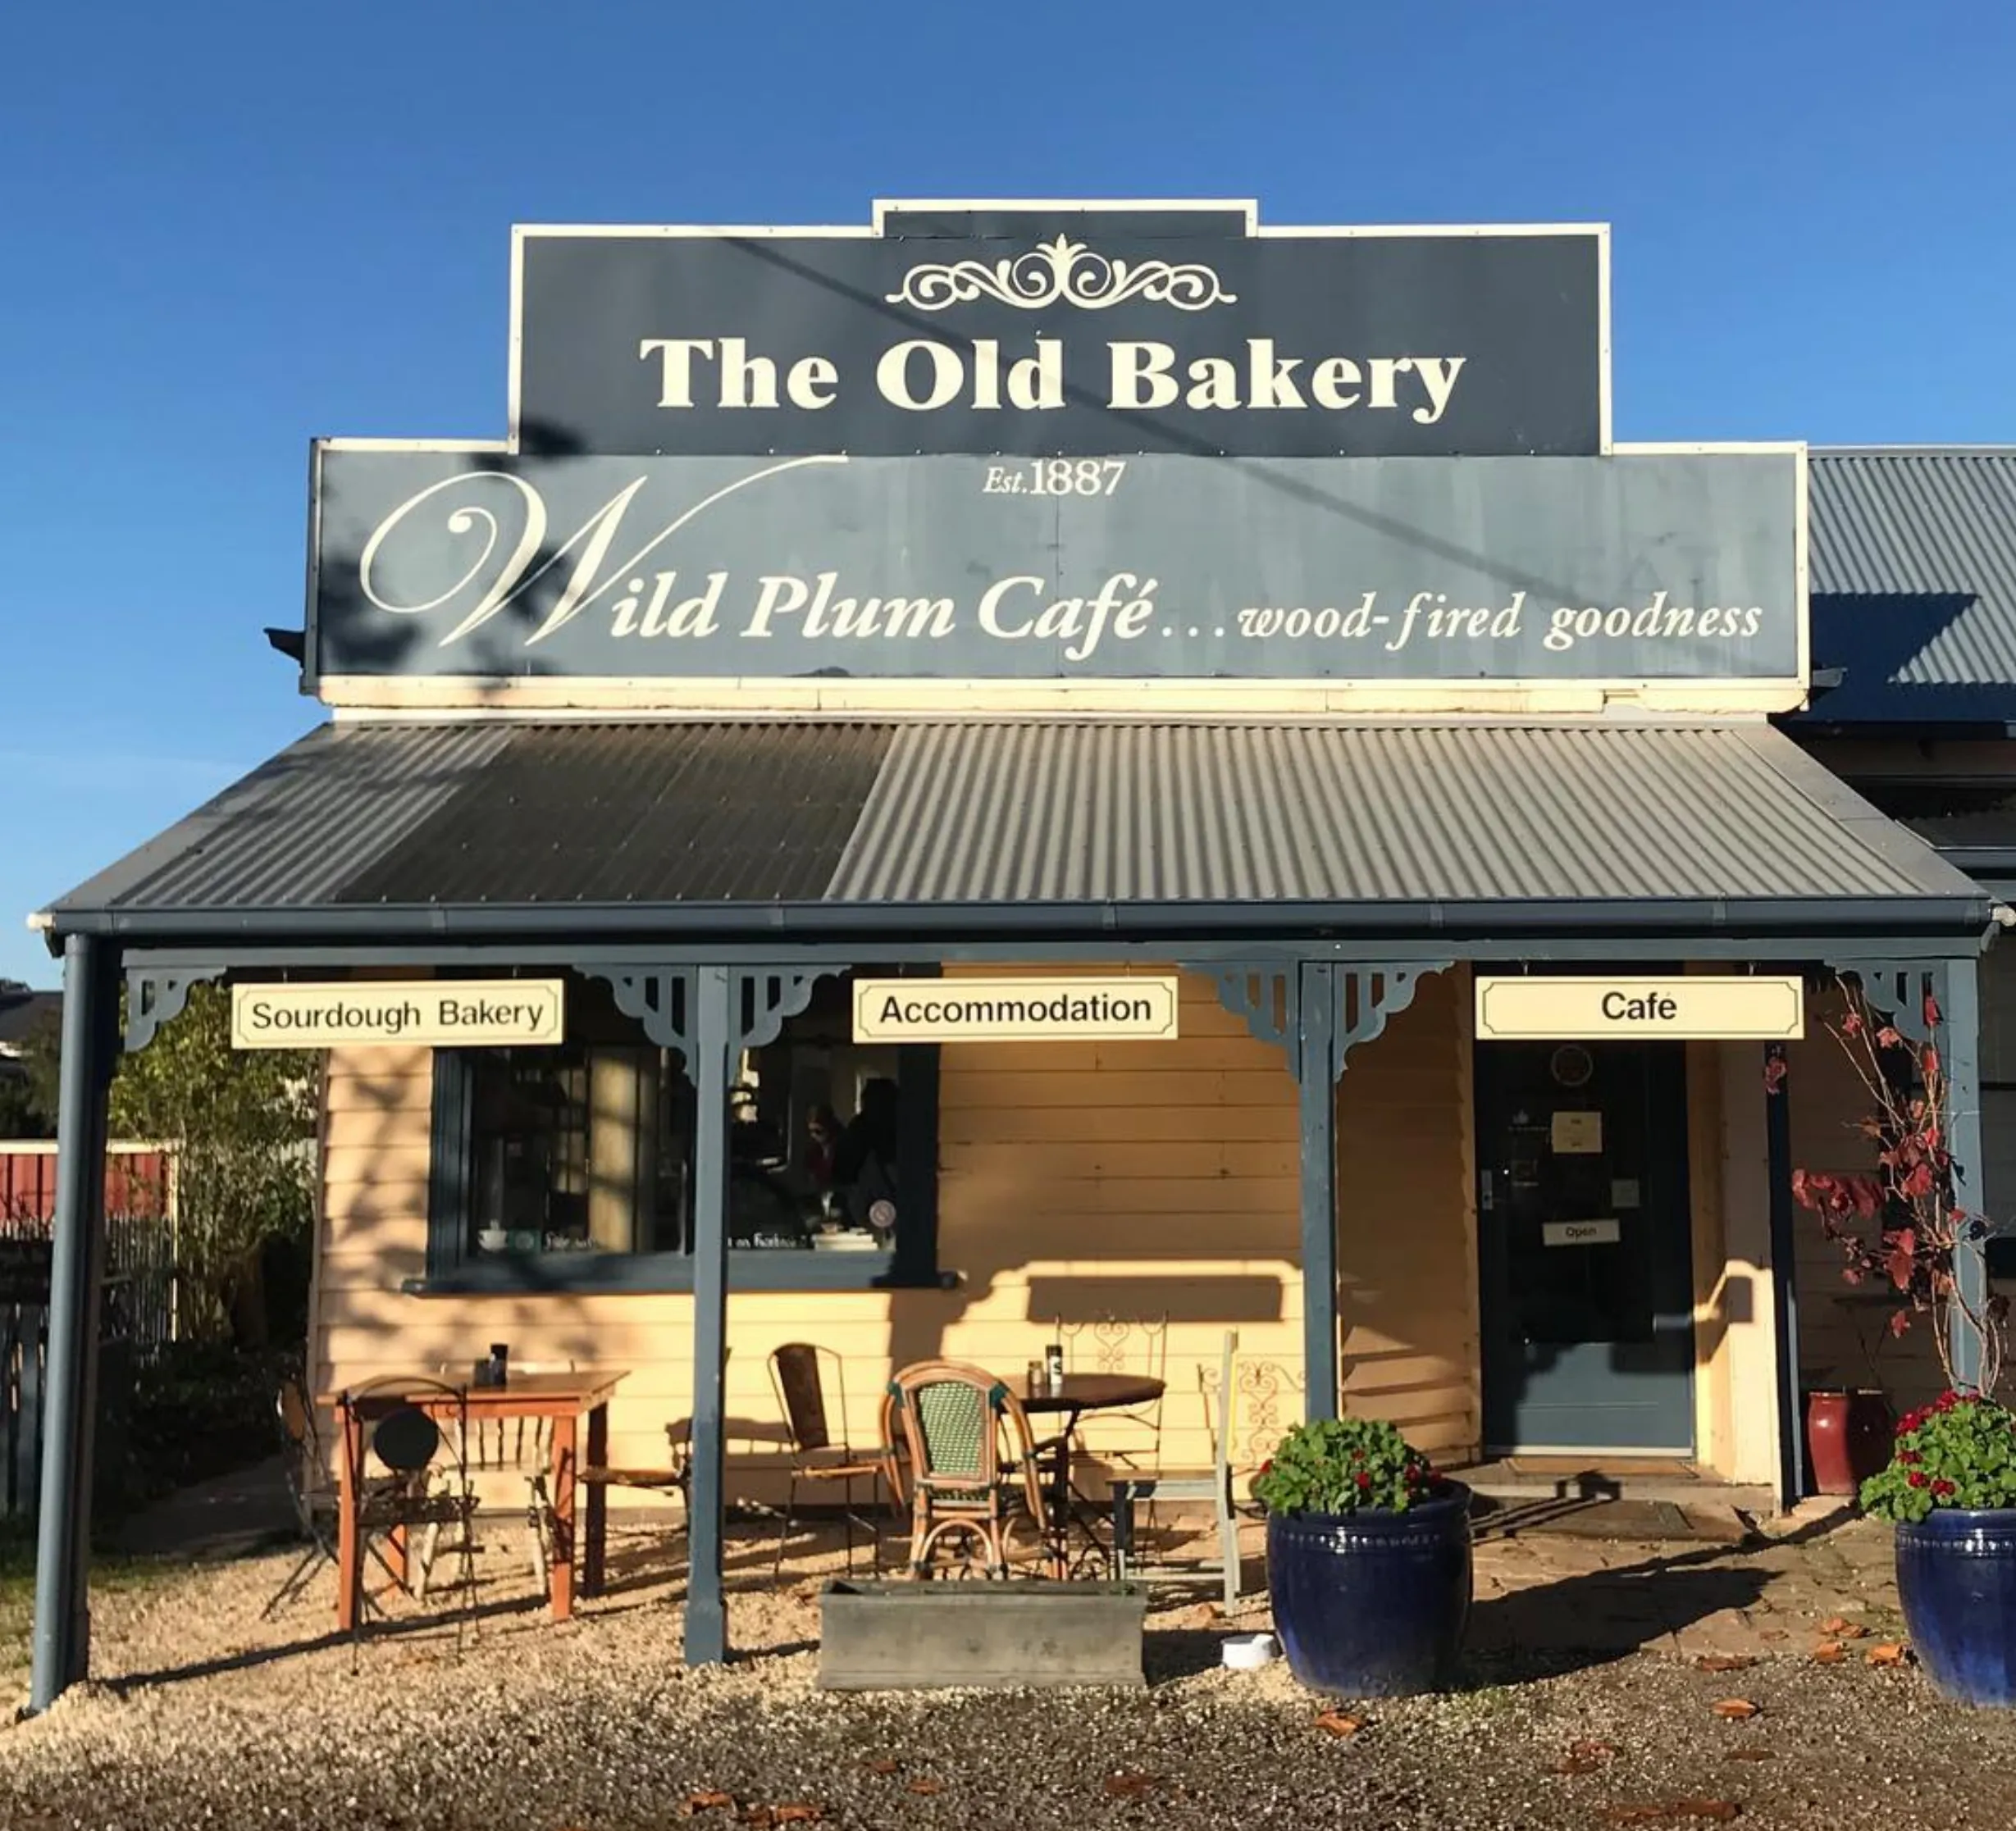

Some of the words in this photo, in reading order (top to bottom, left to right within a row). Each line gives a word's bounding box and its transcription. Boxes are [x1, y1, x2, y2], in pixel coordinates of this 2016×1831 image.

[640, 338, 838, 409] The
[876, 338, 1066, 411] Old
[1107, 338, 1466, 424] Bakery
[360, 454, 849, 647] Wild
[739, 572, 956, 640] Plum
[1541, 590, 1763, 652] goodness
[252, 1002, 420, 1034] Sourdough
[439, 1000, 544, 1031] Bakery
[880, 993, 1152, 1024] Accommodation
[1602, 991, 1677, 1021] Café
[1566, 1225, 1598, 1241] Open
